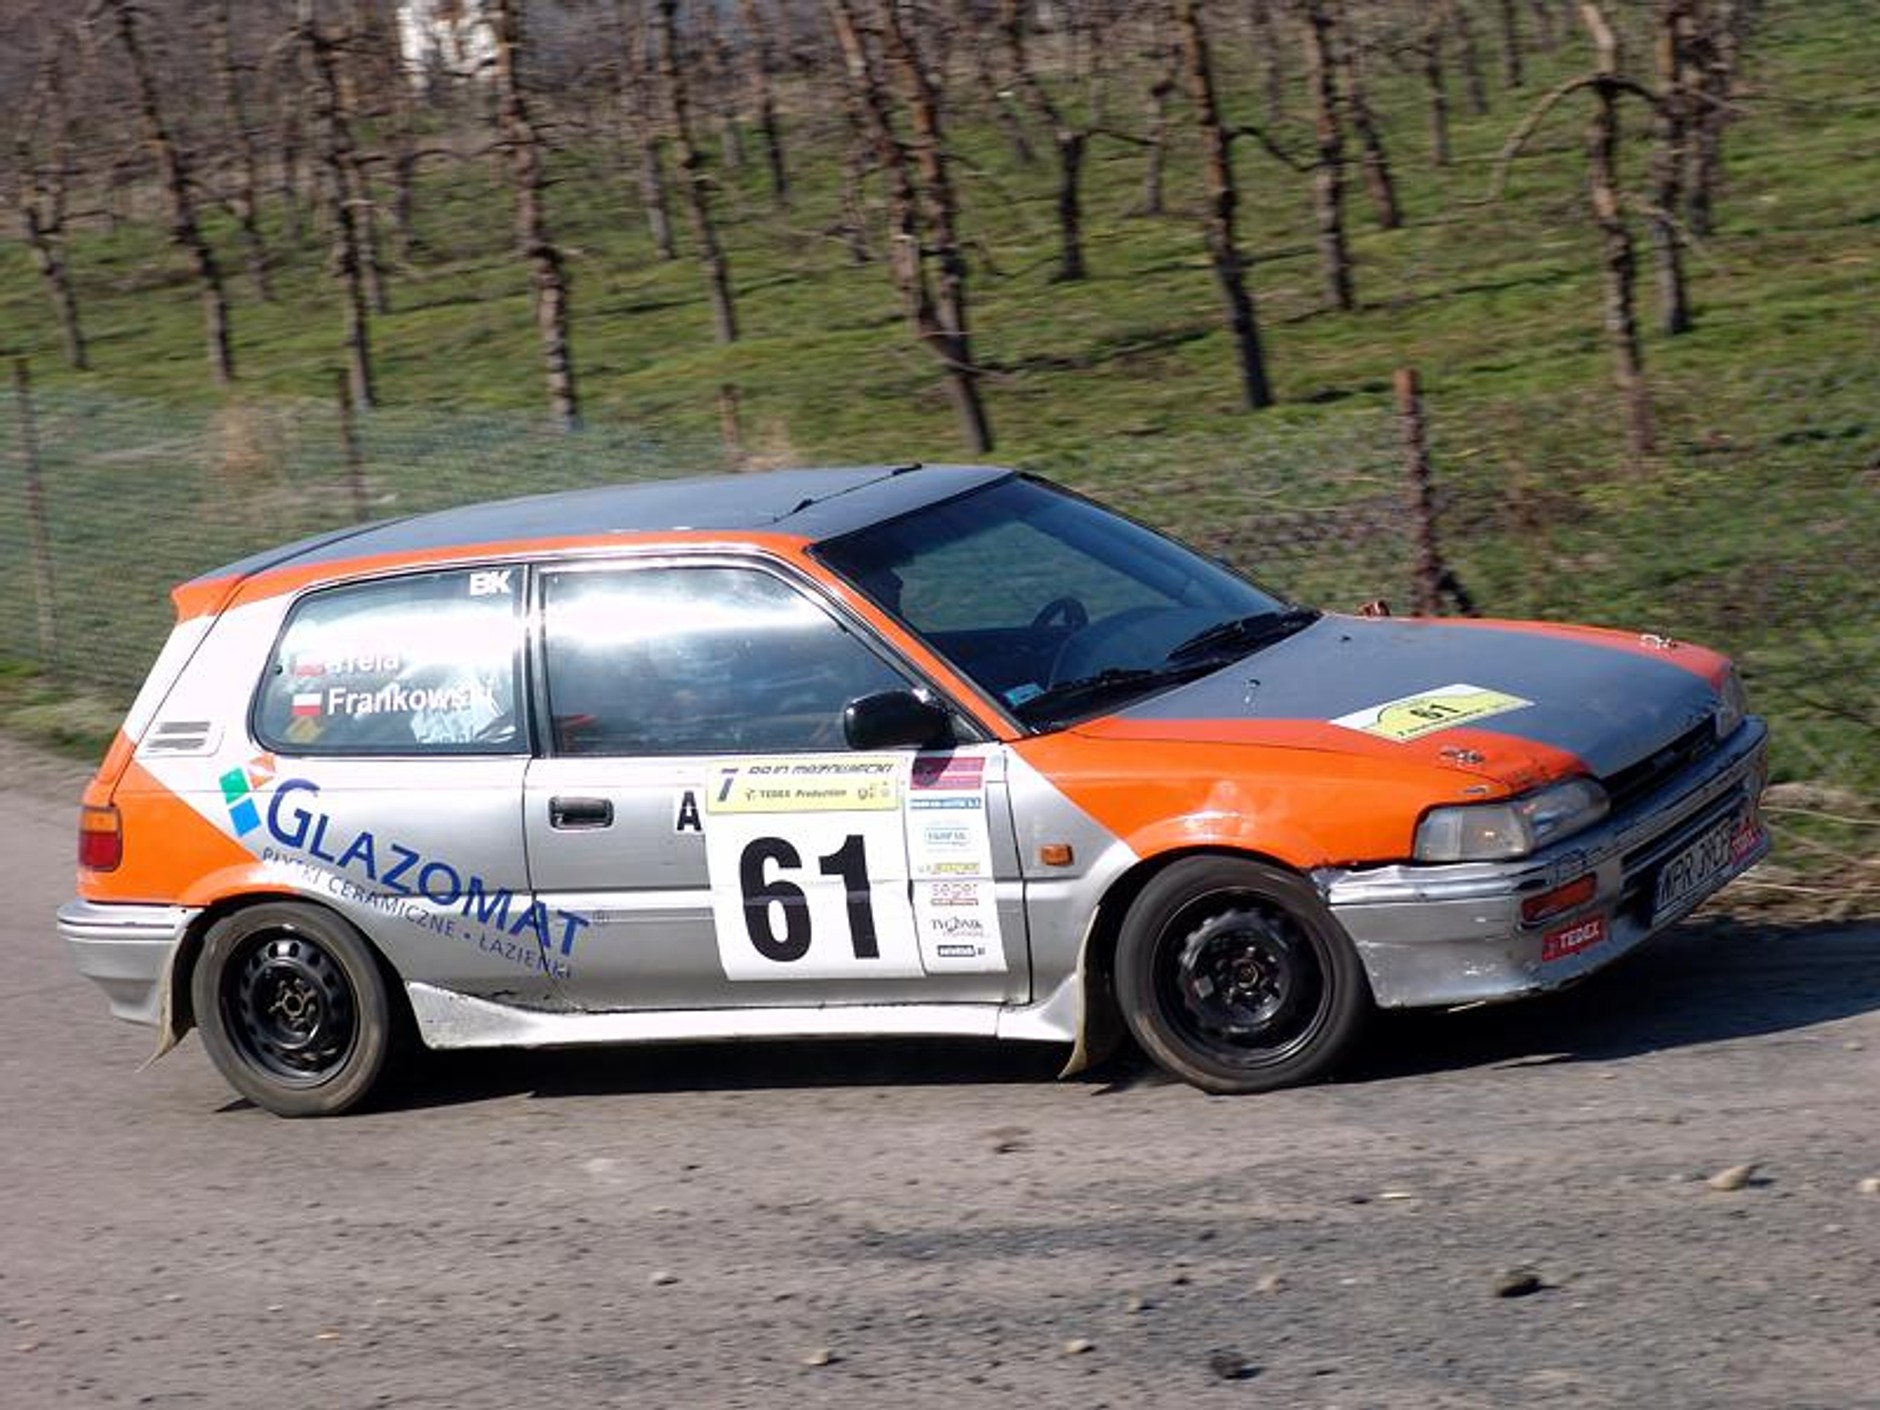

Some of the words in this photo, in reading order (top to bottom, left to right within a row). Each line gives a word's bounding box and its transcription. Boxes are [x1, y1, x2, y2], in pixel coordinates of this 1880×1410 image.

[469, 570, 512, 596] BK
[1409, 702, 1460, 720] 61
[717, 767, 740, 802] 7
[676, 790, 702, 832] A
[267, 777, 591, 956] GLAZOMAT
[328, 875, 457, 937] CERAMICZNE
[738, 833, 881, 963] 61
[1559, 920, 1600, 950] TEDEX
